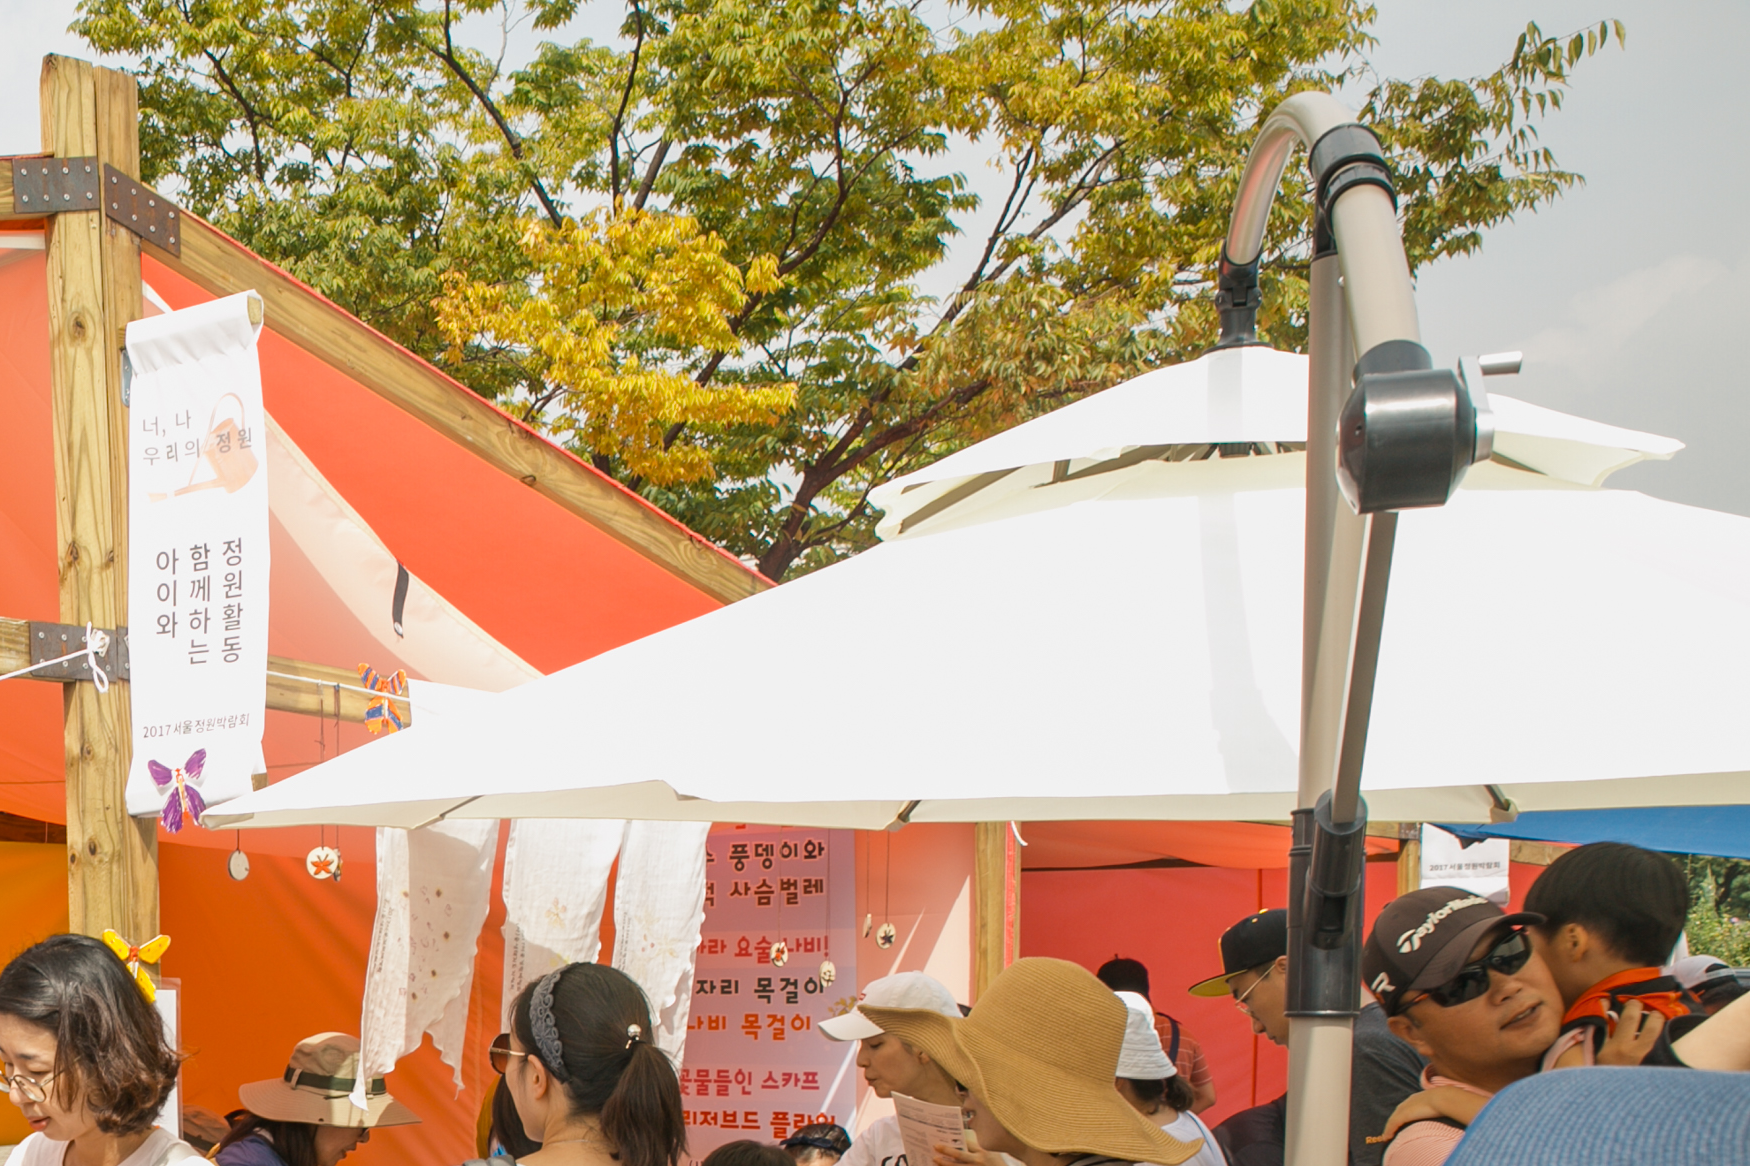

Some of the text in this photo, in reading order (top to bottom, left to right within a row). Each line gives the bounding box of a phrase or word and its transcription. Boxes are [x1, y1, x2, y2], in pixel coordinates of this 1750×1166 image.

[142, 409, 191, 437] 너, 나
[143, 427, 252, 466] 우리의 정원
[156, 548, 180, 638] 아이와
[188, 543, 211, 665] 함께하는
[729, 840, 825, 872] 풍뎅이와
[729, 878, 824, 906] 사슴벌레
[734, 936, 773, 964] 요술
[696, 977, 824, 1005] 자리 목걸이
[741, 1013, 811, 1041] 목걸이
[681, 1069, 820, 1097] 꽃물들인 스카프
